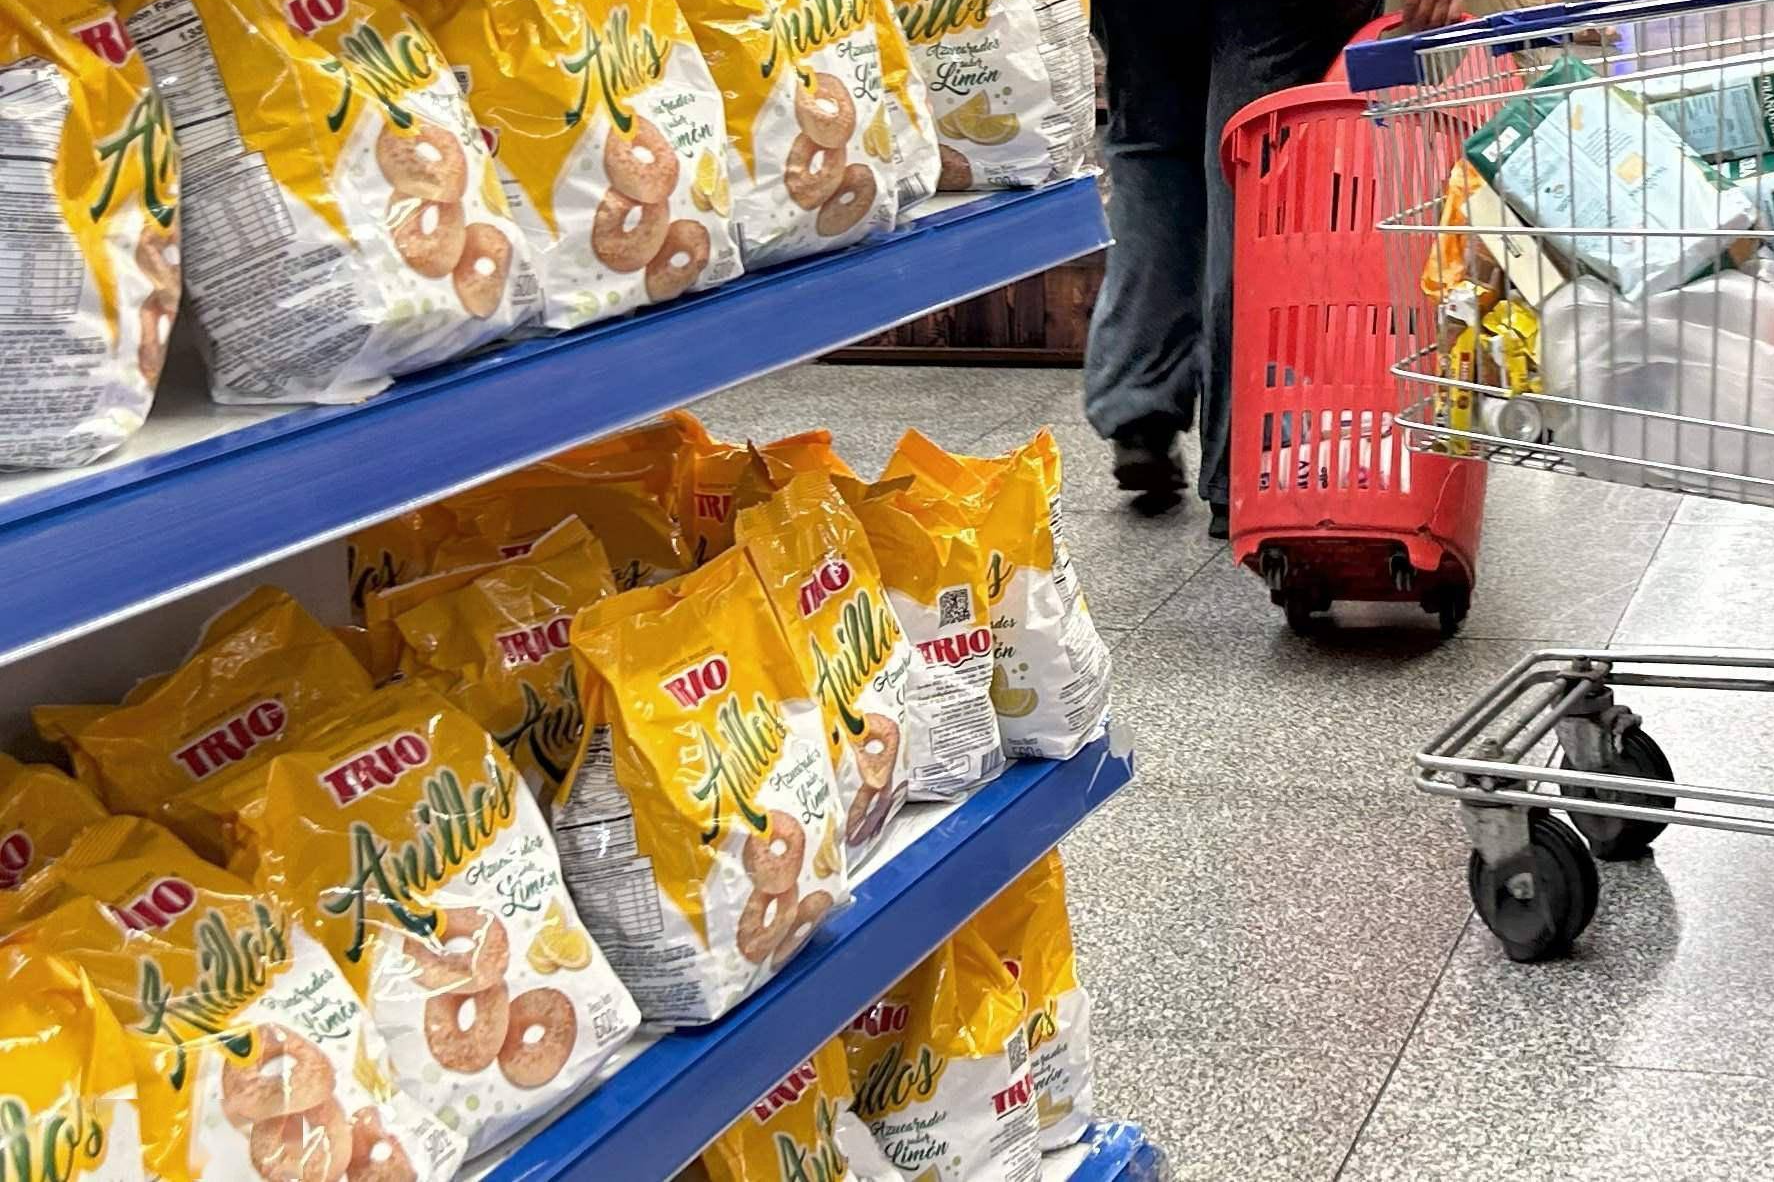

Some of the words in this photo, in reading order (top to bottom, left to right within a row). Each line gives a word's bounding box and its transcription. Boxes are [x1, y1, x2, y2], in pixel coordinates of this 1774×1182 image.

[917, 628, 991, 664] TRIO
[175, 700, 287, 778] TRIO
[323, 733, 429, 805] TRIO
[323, 763, 513, 963] Anillos
[992, 1073, 1034, 1114] TRI
[885, 1139, 950, 1170] Limón
